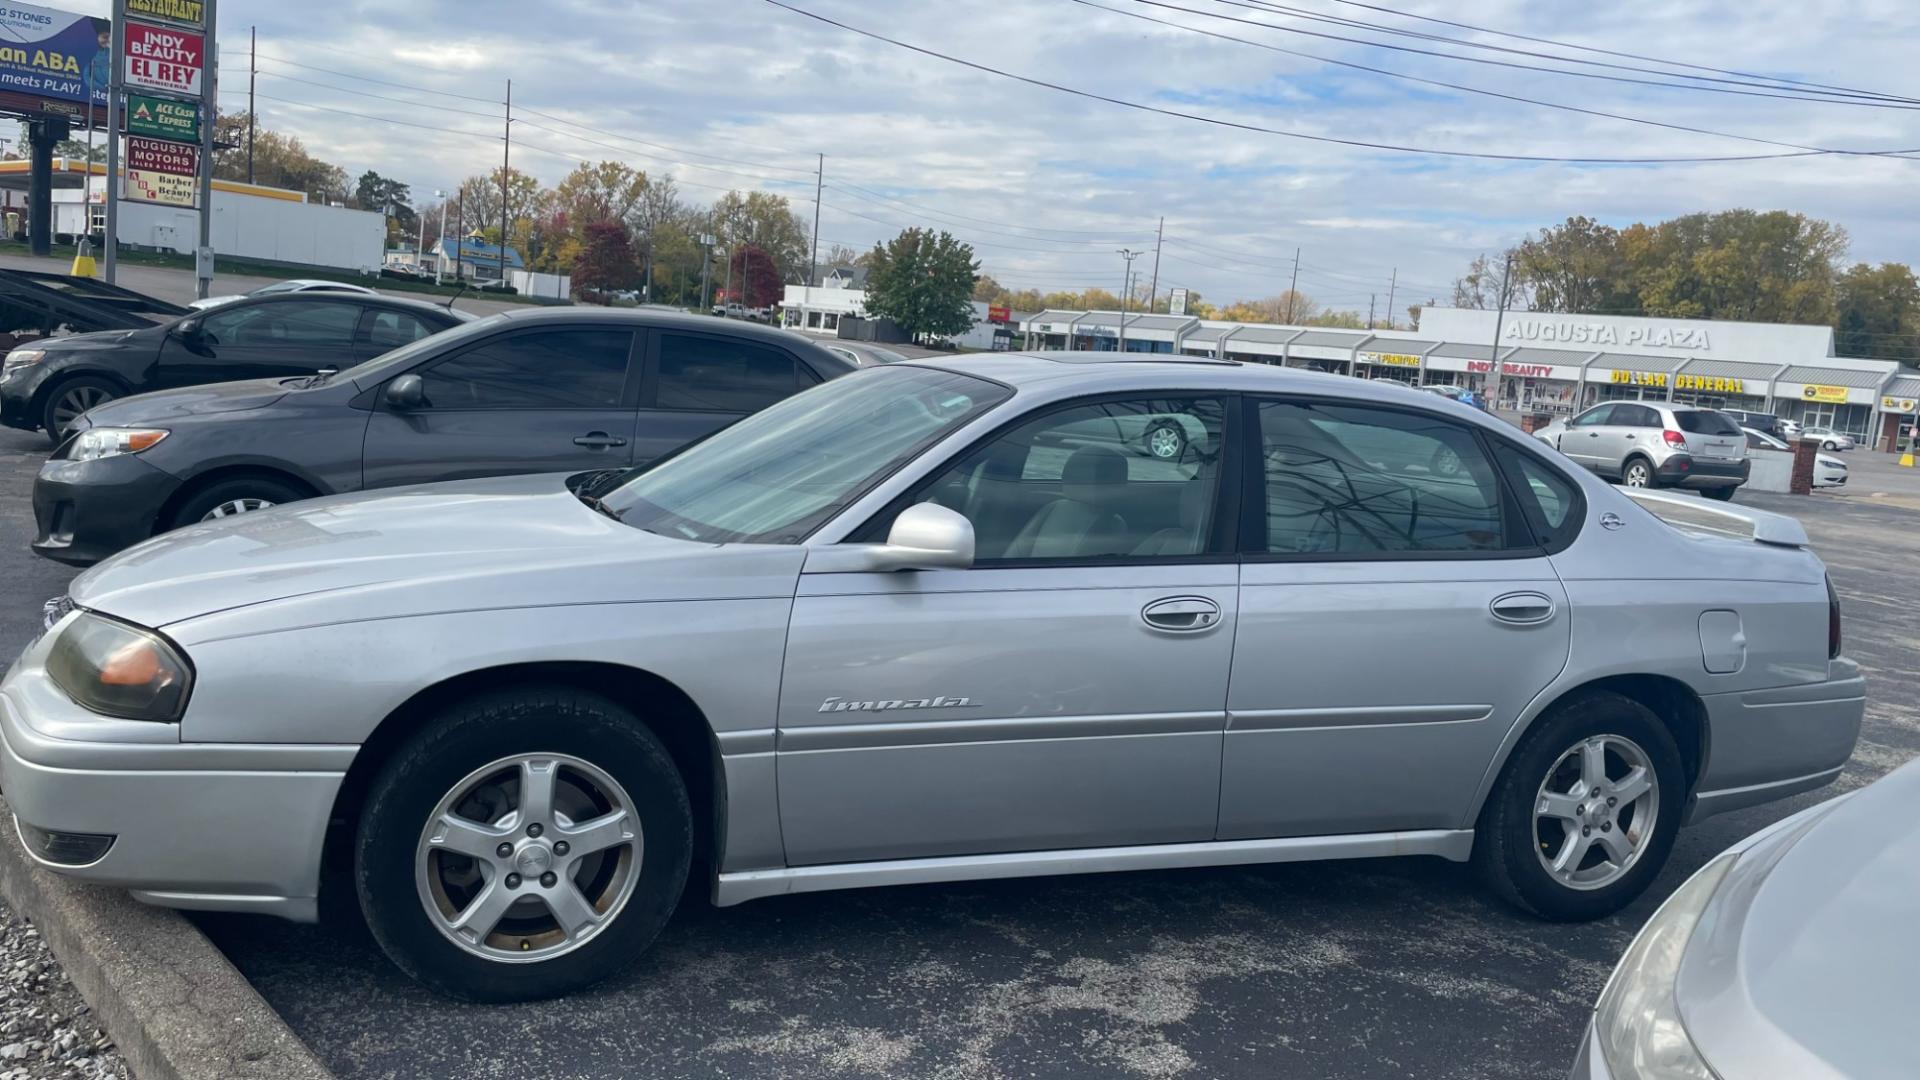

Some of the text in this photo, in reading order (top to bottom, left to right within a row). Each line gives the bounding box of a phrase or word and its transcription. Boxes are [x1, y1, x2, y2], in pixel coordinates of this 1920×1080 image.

[9, 9, 52, 25] STONES
[144, 31, 185, 50] INDY
[131, 41, 197, 64] BEAUTY
[32, 49, 80, 74] ABA
[131, 58, 195, 85] EL REY
[1, 74, 81, 95] meets PLAY!
[155, 103, 173, 115] ACE
[131, 139, 193, 156] AUGUSTA
[130, 160, 153, 168] SALES
[135, 151, 190, 166] MOTORS
[159, 175, 192, 187] Barber
[158, 186, 192, 199] Beauty
[1506, 319, 1711, 350] AUGUSTA PLAZA
[1503, 363, 1553, 377] BEAUTY
[1611, 368, 1744, 393] DOLLAR GENERAL
